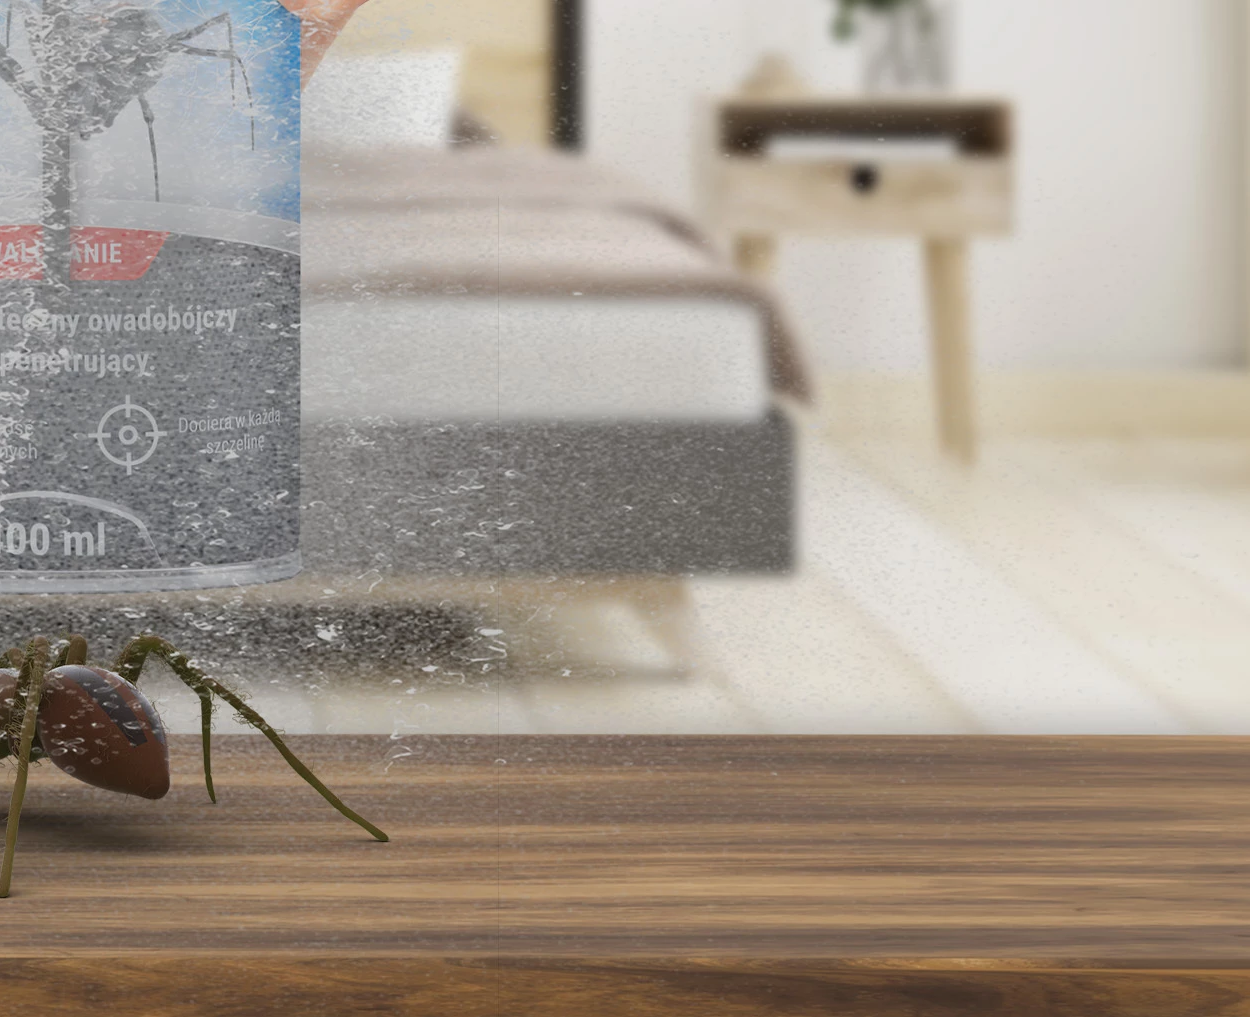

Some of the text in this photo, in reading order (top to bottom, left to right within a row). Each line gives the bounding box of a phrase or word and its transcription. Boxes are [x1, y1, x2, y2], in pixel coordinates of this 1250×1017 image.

[88, 304, 238, 334] owadobójczy
[178, 408, 281, 433] Dociera w każdą
[206, 434, 265, 455] szczelinę
[63, 522, 106, 556] ml
